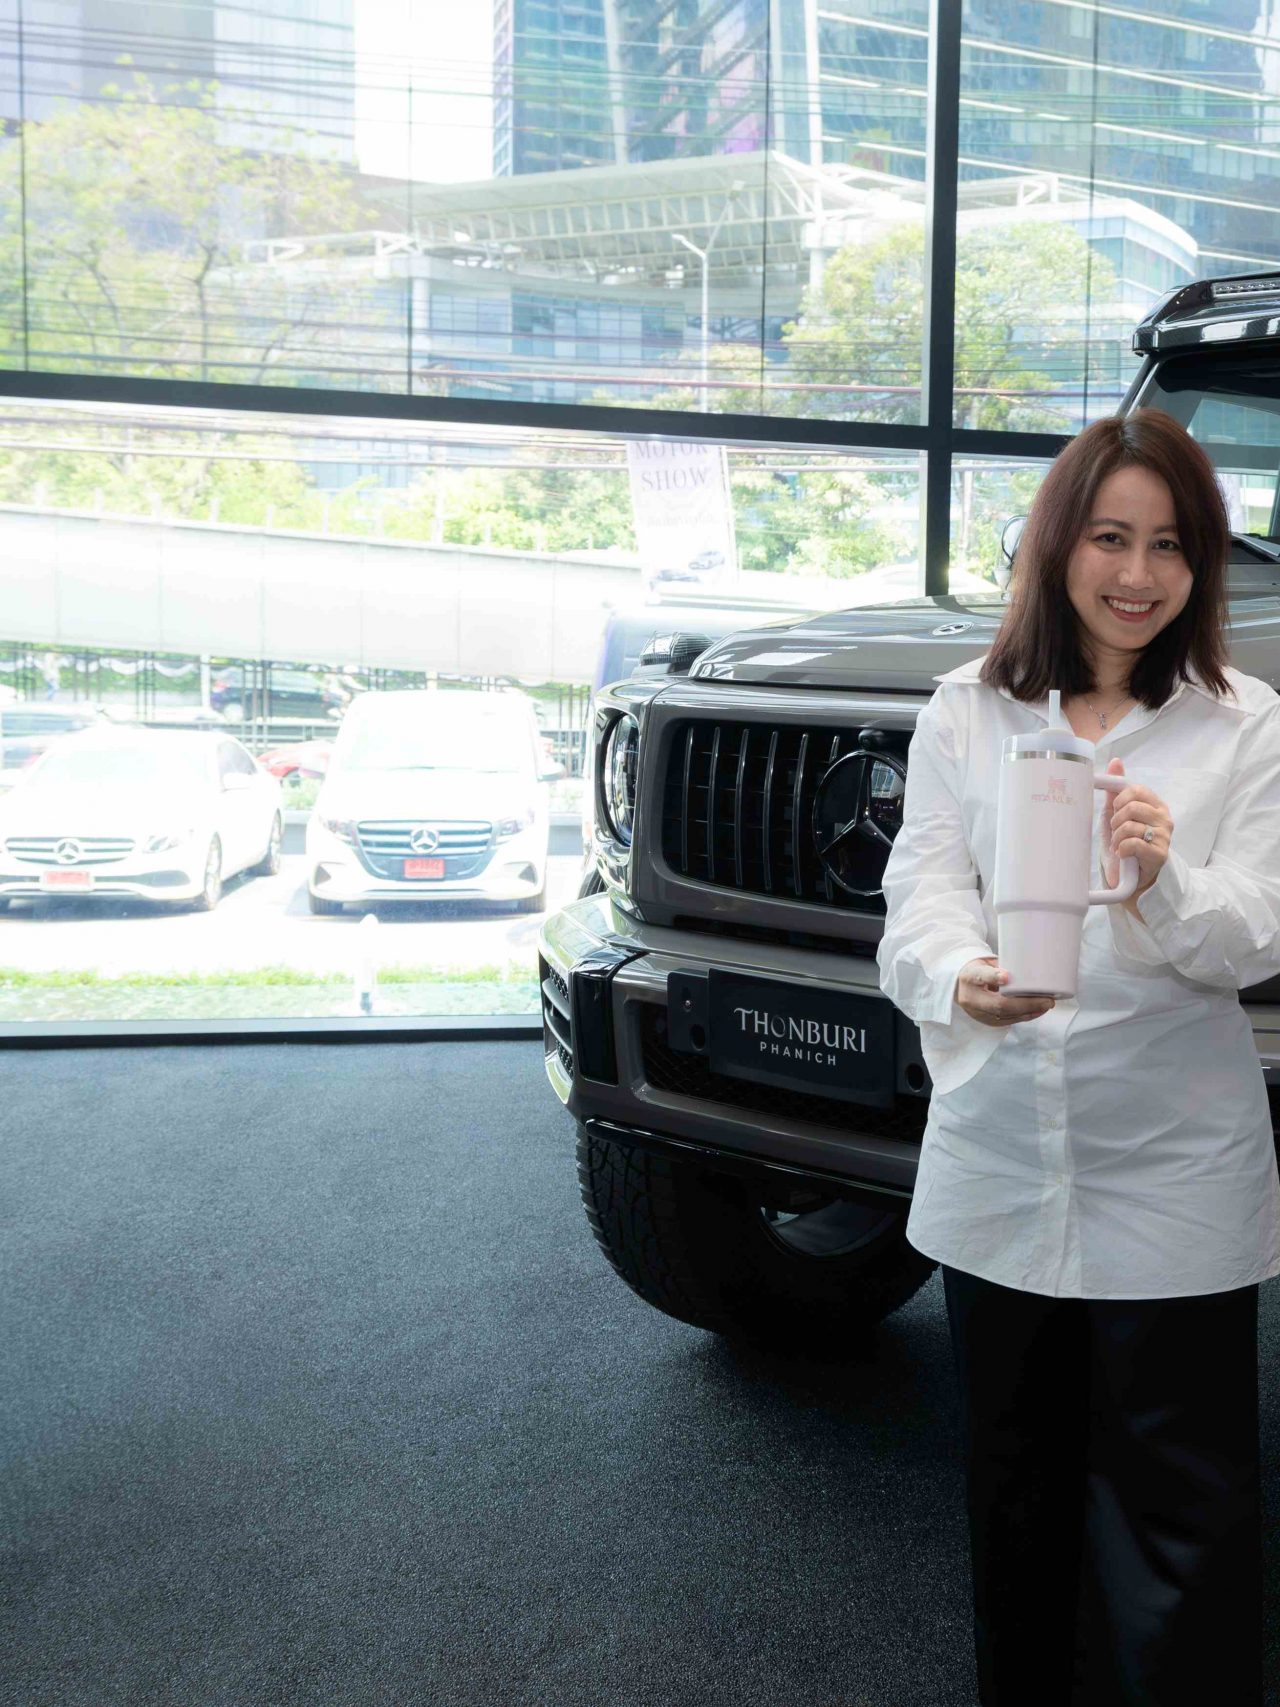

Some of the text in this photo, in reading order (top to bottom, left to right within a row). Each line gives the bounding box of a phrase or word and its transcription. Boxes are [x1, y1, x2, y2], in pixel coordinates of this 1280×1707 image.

[641, 467, 709, 491] SHOW
[734, 1007, 866, 1053] THONBURI
[760, 1041, 836, 1066] PHANICH
